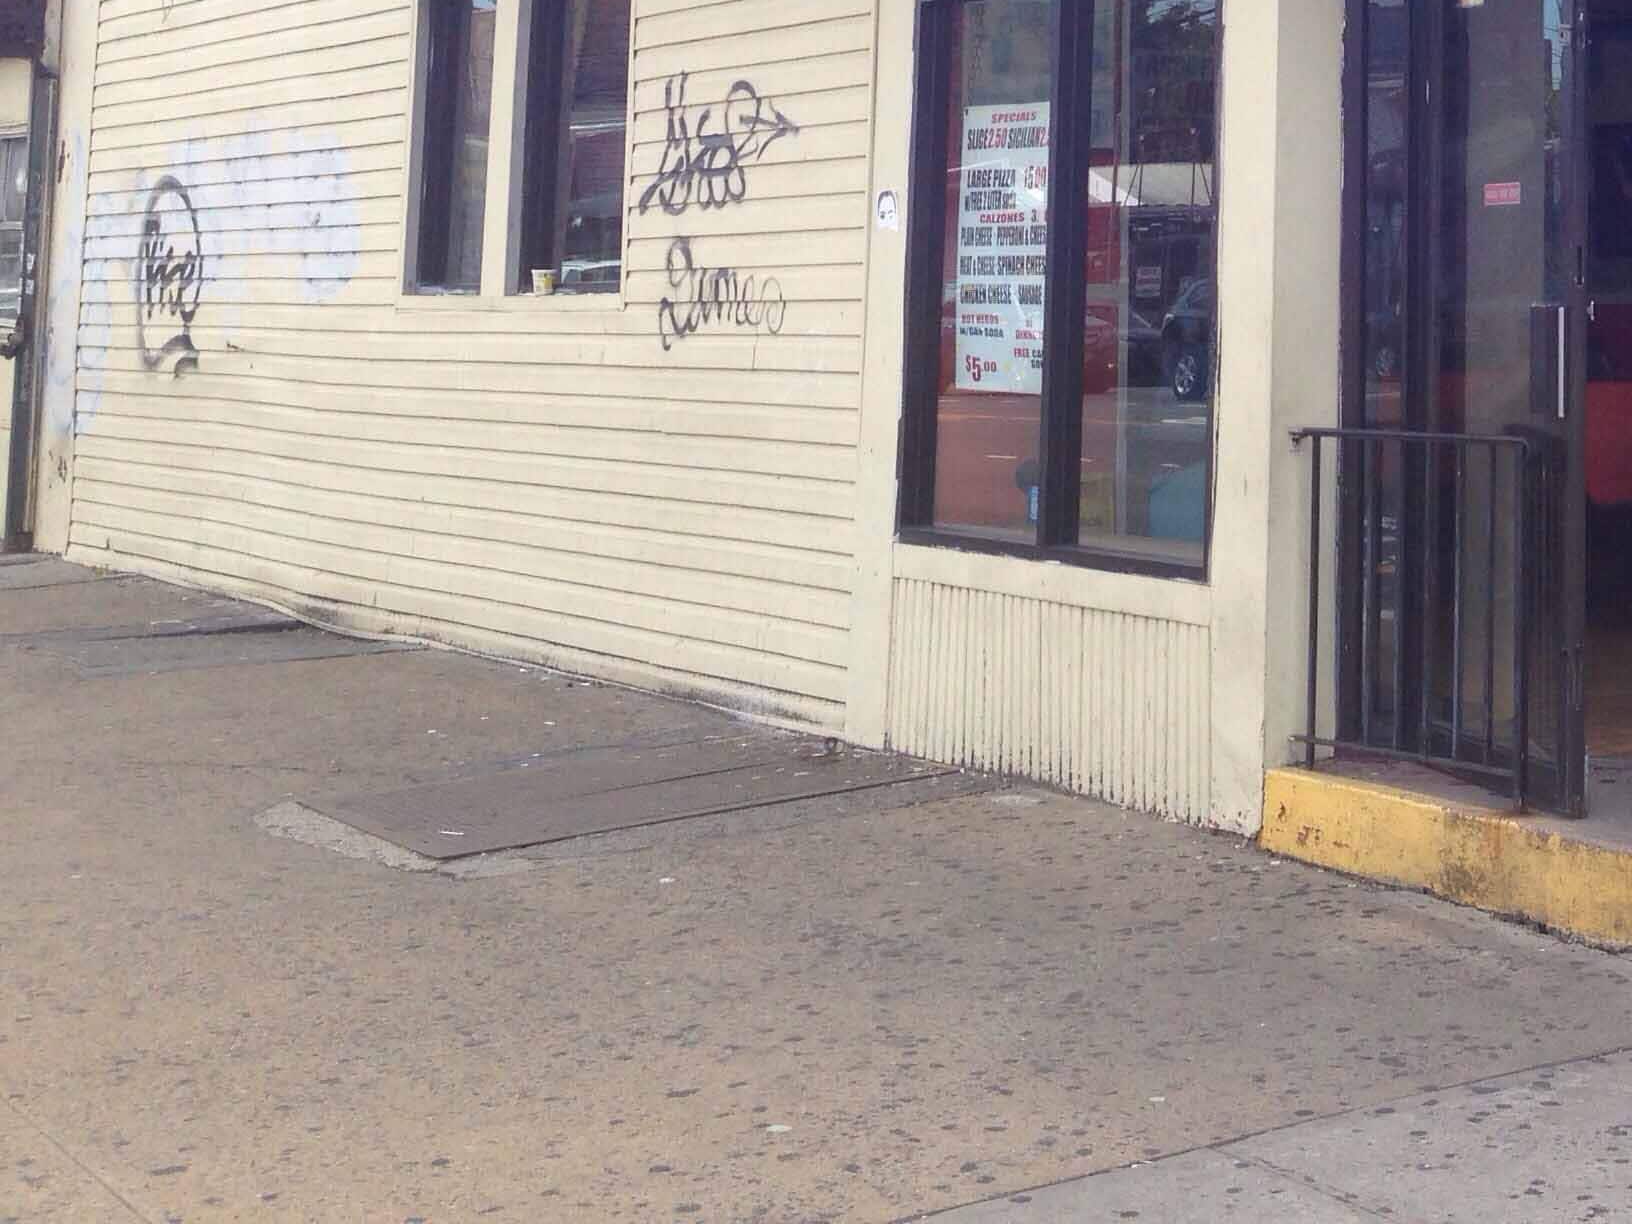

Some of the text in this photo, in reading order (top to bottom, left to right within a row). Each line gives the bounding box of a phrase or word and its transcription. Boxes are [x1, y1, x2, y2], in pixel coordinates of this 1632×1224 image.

[992, 111, 1036, 124] SPECIALS
[967, 127, 987, 150] SLICE
[967, 169, 992, 188] LARGE
[993, 169, 1016, 188] PIZZA
[980, 212, 1024, 223] CALZONES
[966, 354, 998, 382] $5.00
